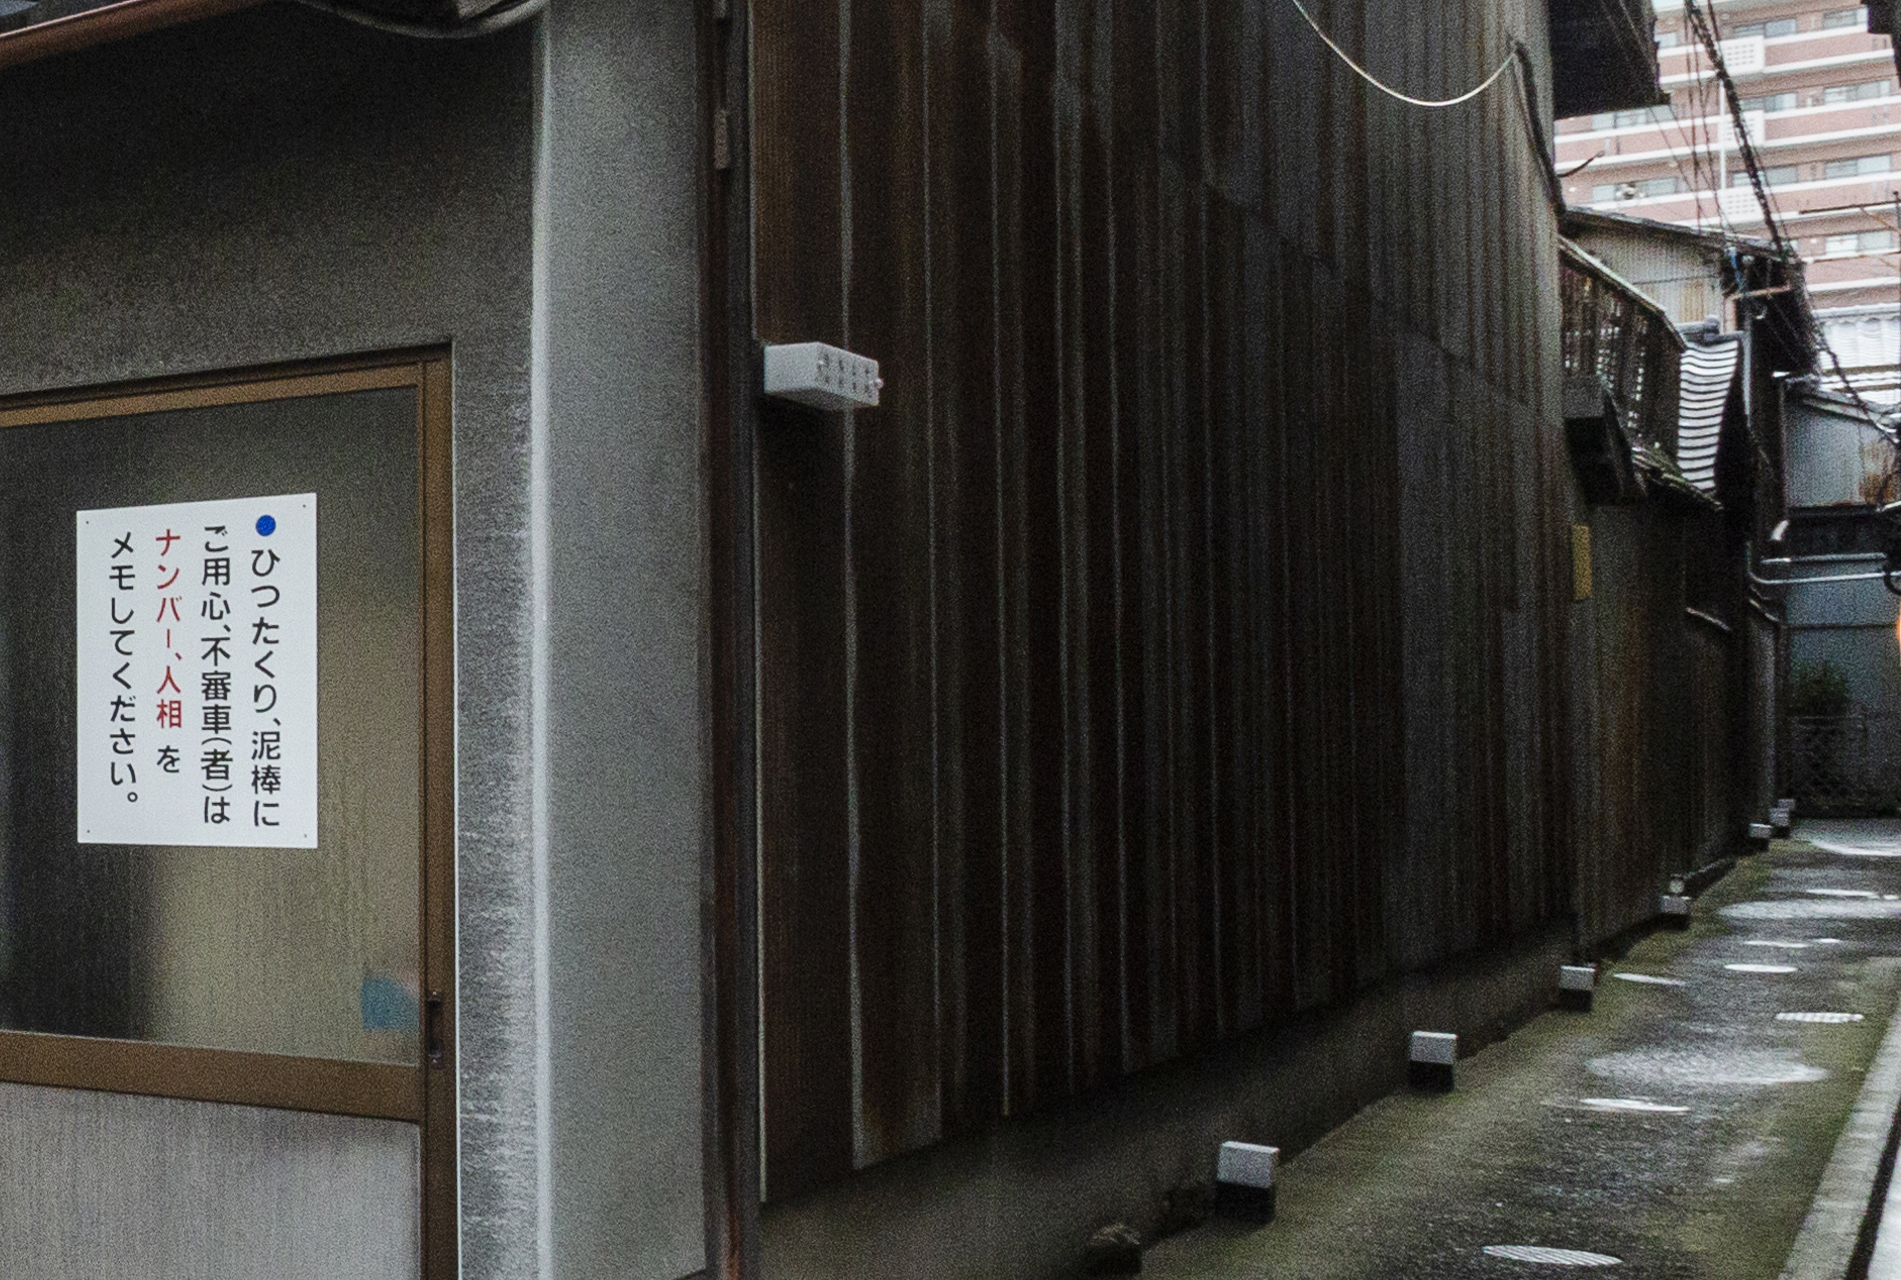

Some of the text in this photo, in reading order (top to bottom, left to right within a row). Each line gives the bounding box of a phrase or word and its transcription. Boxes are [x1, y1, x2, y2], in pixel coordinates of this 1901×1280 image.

[109, 531, 139, 805] メモしてください。
